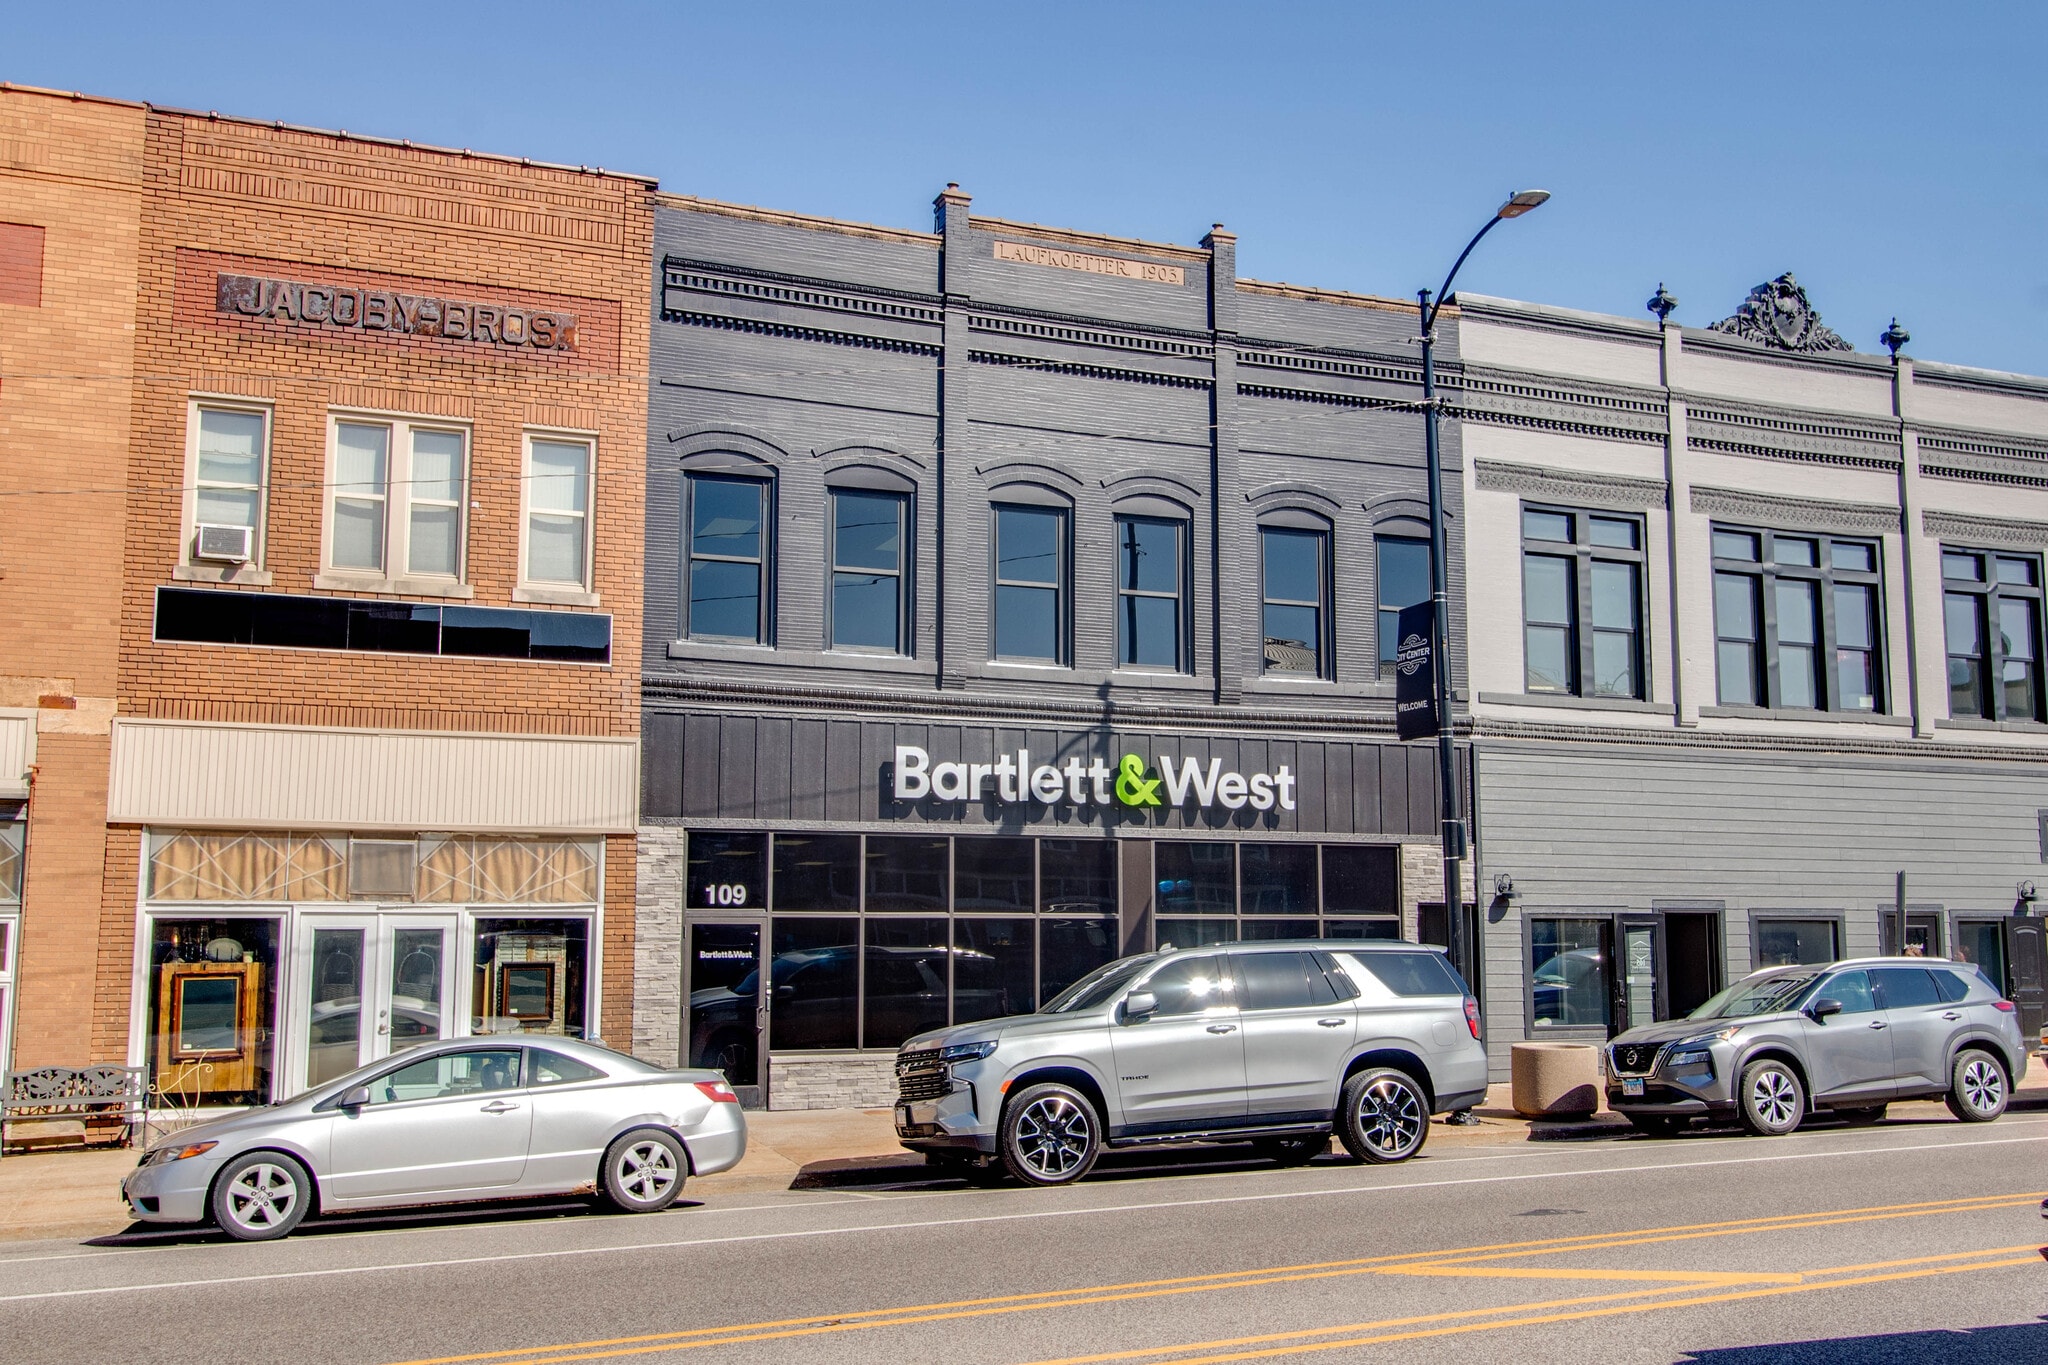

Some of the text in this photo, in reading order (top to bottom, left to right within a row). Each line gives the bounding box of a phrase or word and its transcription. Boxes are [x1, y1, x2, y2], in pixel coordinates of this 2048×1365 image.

[1000, 244, 1130, 276] LAUFKOETTER
[1407, 647, 1430, 660] CENTER
[1398, 700, 1428, 713] WELCOME
[894, 745, 1296, 811] Bartlett&West
[705, 884, 746, 905] 109
